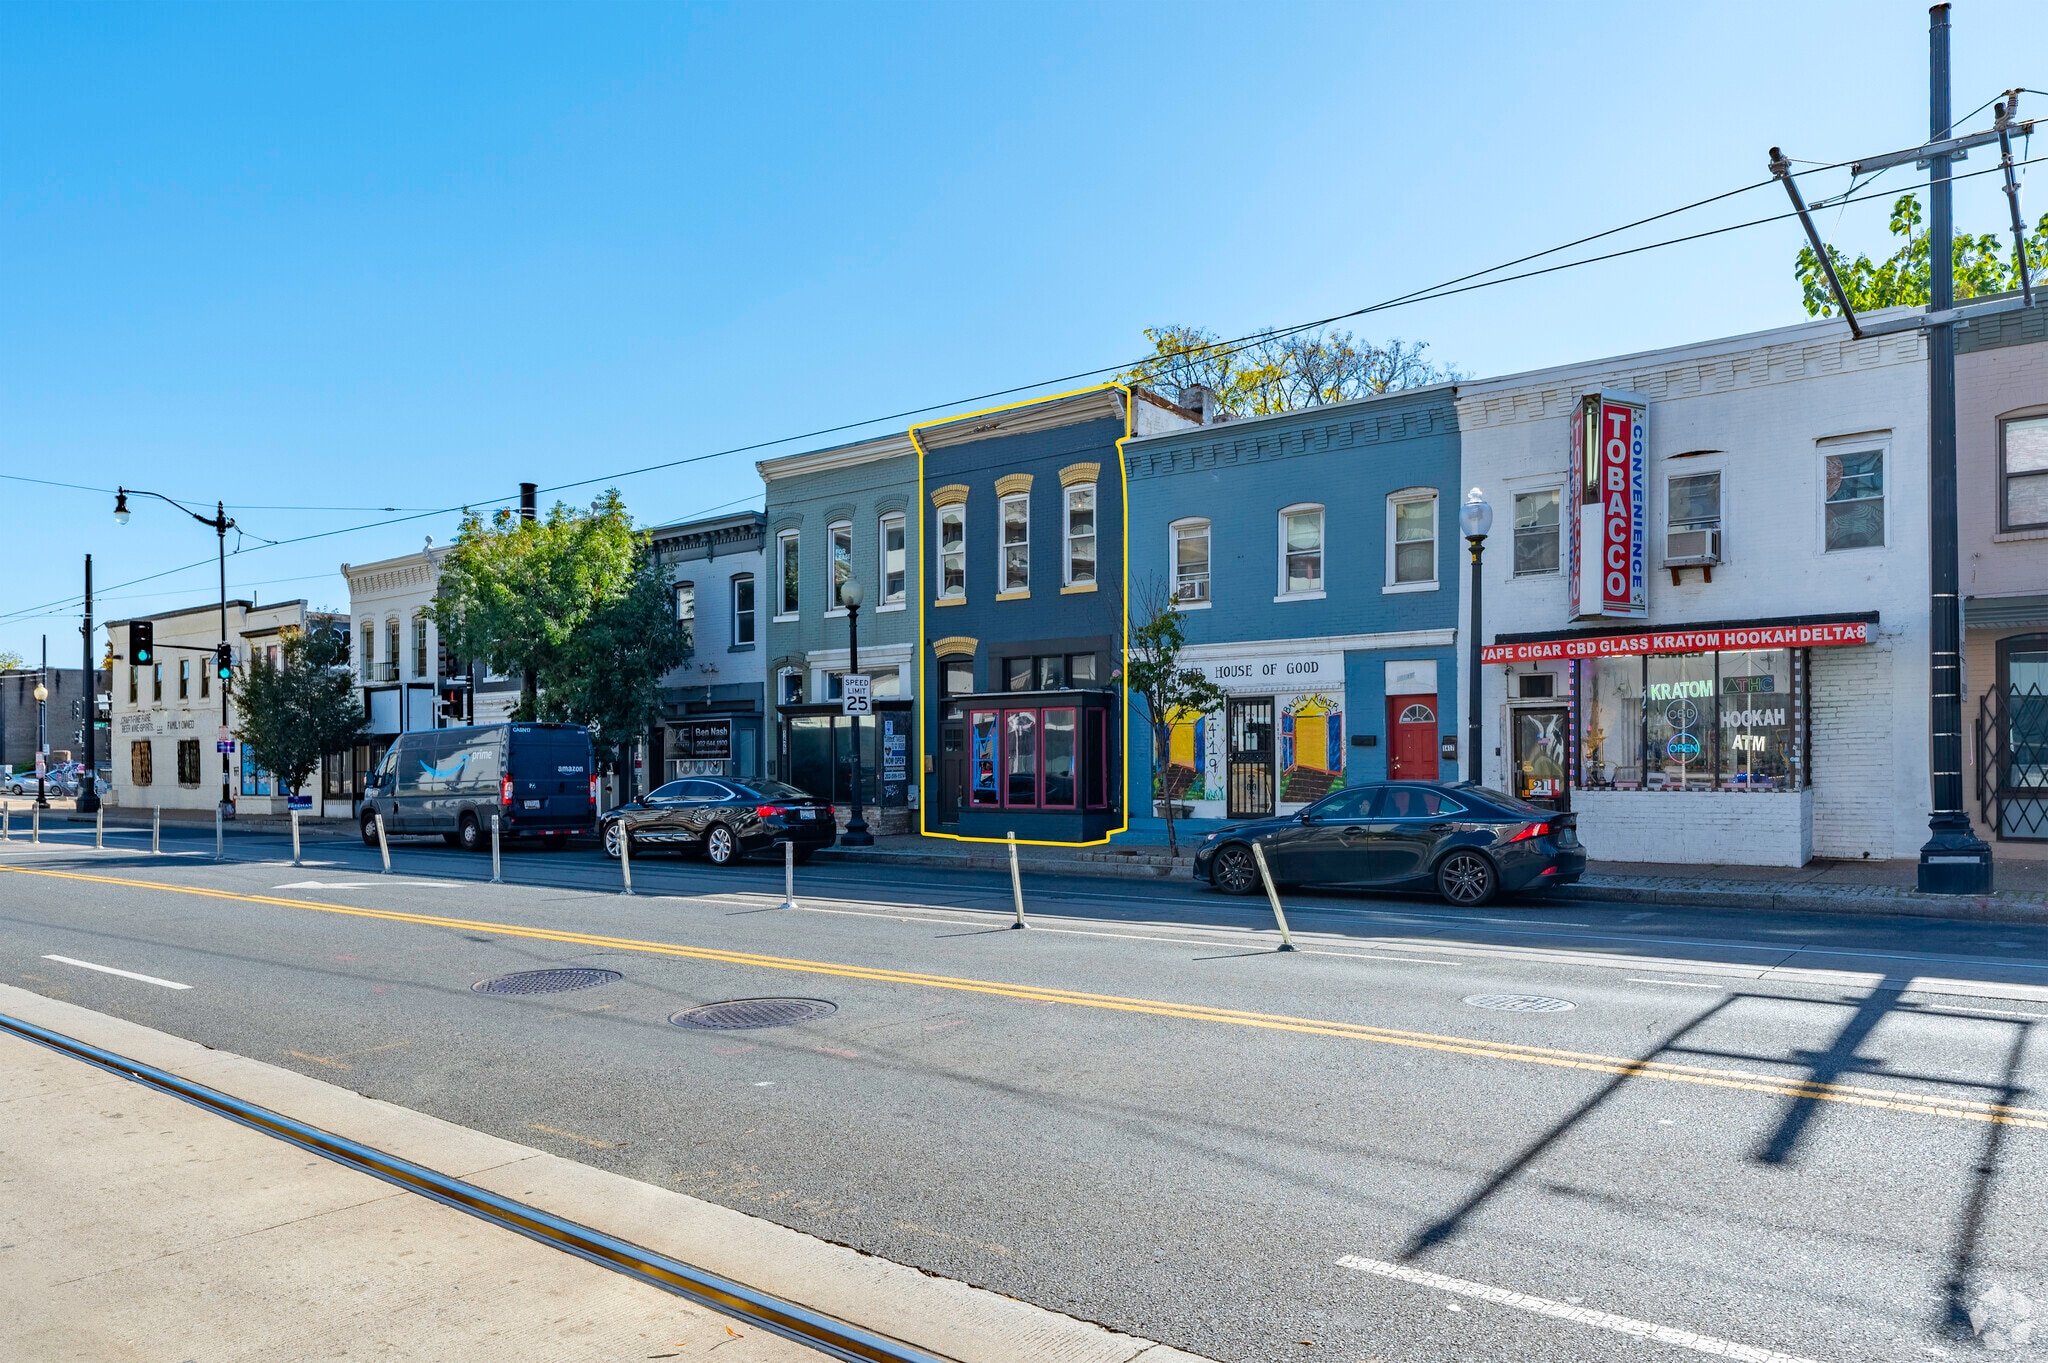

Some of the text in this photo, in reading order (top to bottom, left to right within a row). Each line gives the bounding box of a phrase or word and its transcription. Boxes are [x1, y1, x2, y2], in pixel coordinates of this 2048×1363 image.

[1572, 418, 1581, 601] TOBACCO
[1606, 412, 1627, 597] TOBACCO
[1632, 424, 1643, 588] CONVENIENCE
[1481, 647, 1514, 661] VAPE
[1517, 643, 1562, 659] CIGAR
[1566, 642, 1596, 655] CBD
[1599, 637, 1649, 652] GLASS
[1653, 632, 1720, 649] KRATOM
[1724, 629, 1797, 646] HOOKAH
[1215, 664, 1253, 679] HOUSE
[1262, 663, 1278, 676] OF
[1286, 661, 1319, 675] GOOD
[847, 687, 866, 695] LIMIT
[1650, 680, 1713, 700] KRATOM
[847, 696, 868, 711] 25
[1668, 708, 1695, 720] CBD
[1720, 708, 1786, 728] HOOKAH
[695, 727, 710, 736] Ben
[710, 726, 728, 736] Nash
[1669, 744, 1699, 753] OPEN
[1731, 734, 1766, 752] ATM
[471, 749, 493, 762] prime
